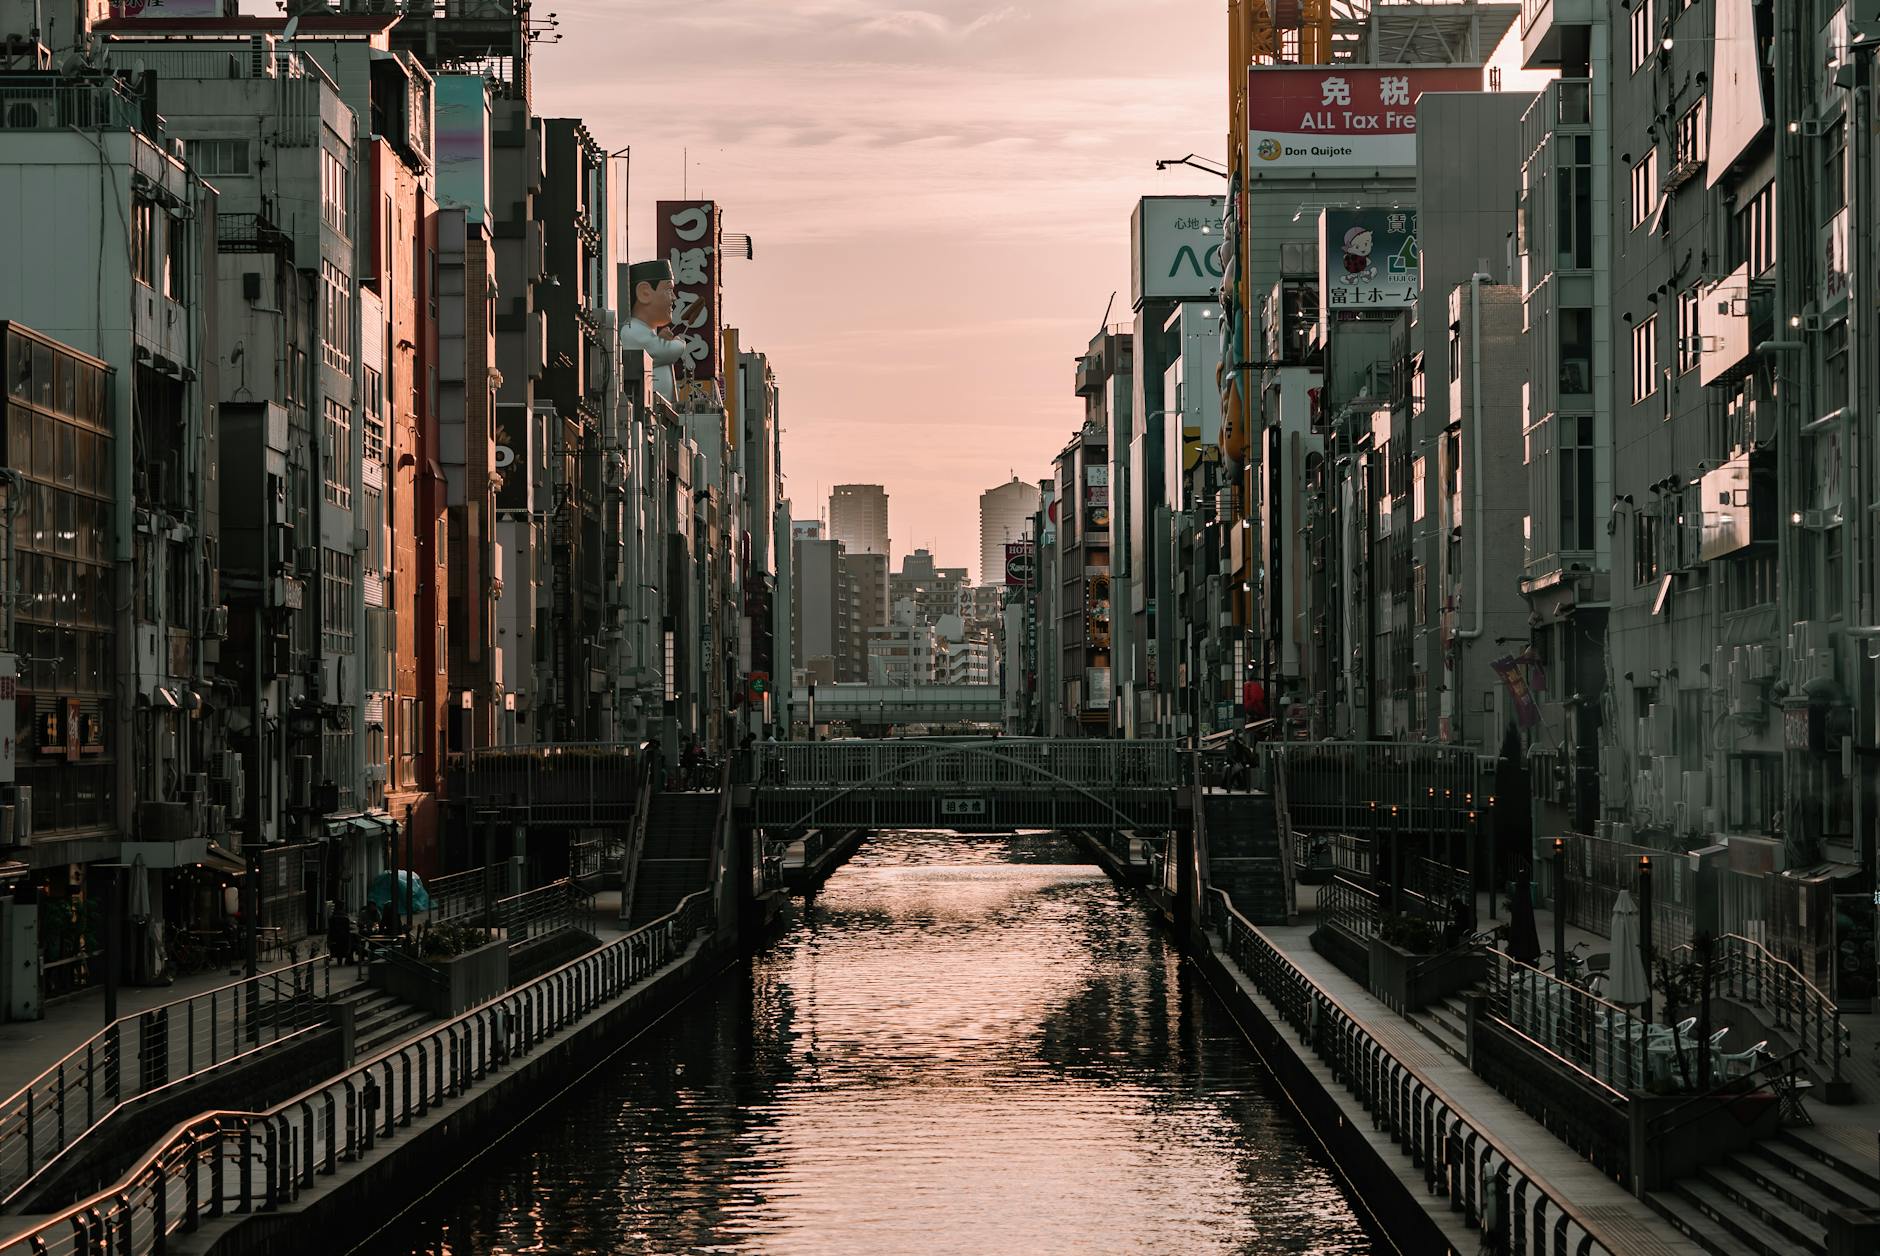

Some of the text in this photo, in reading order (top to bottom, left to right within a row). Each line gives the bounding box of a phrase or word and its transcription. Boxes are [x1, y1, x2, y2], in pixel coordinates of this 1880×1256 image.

[1301, 112, 1336, 129] ALL
[1343, 112, 1380, 129] Tax
[1285, 146, 1352, 158] Don Quijote
[1331, 287, 1417, 304] 富士ホーム
